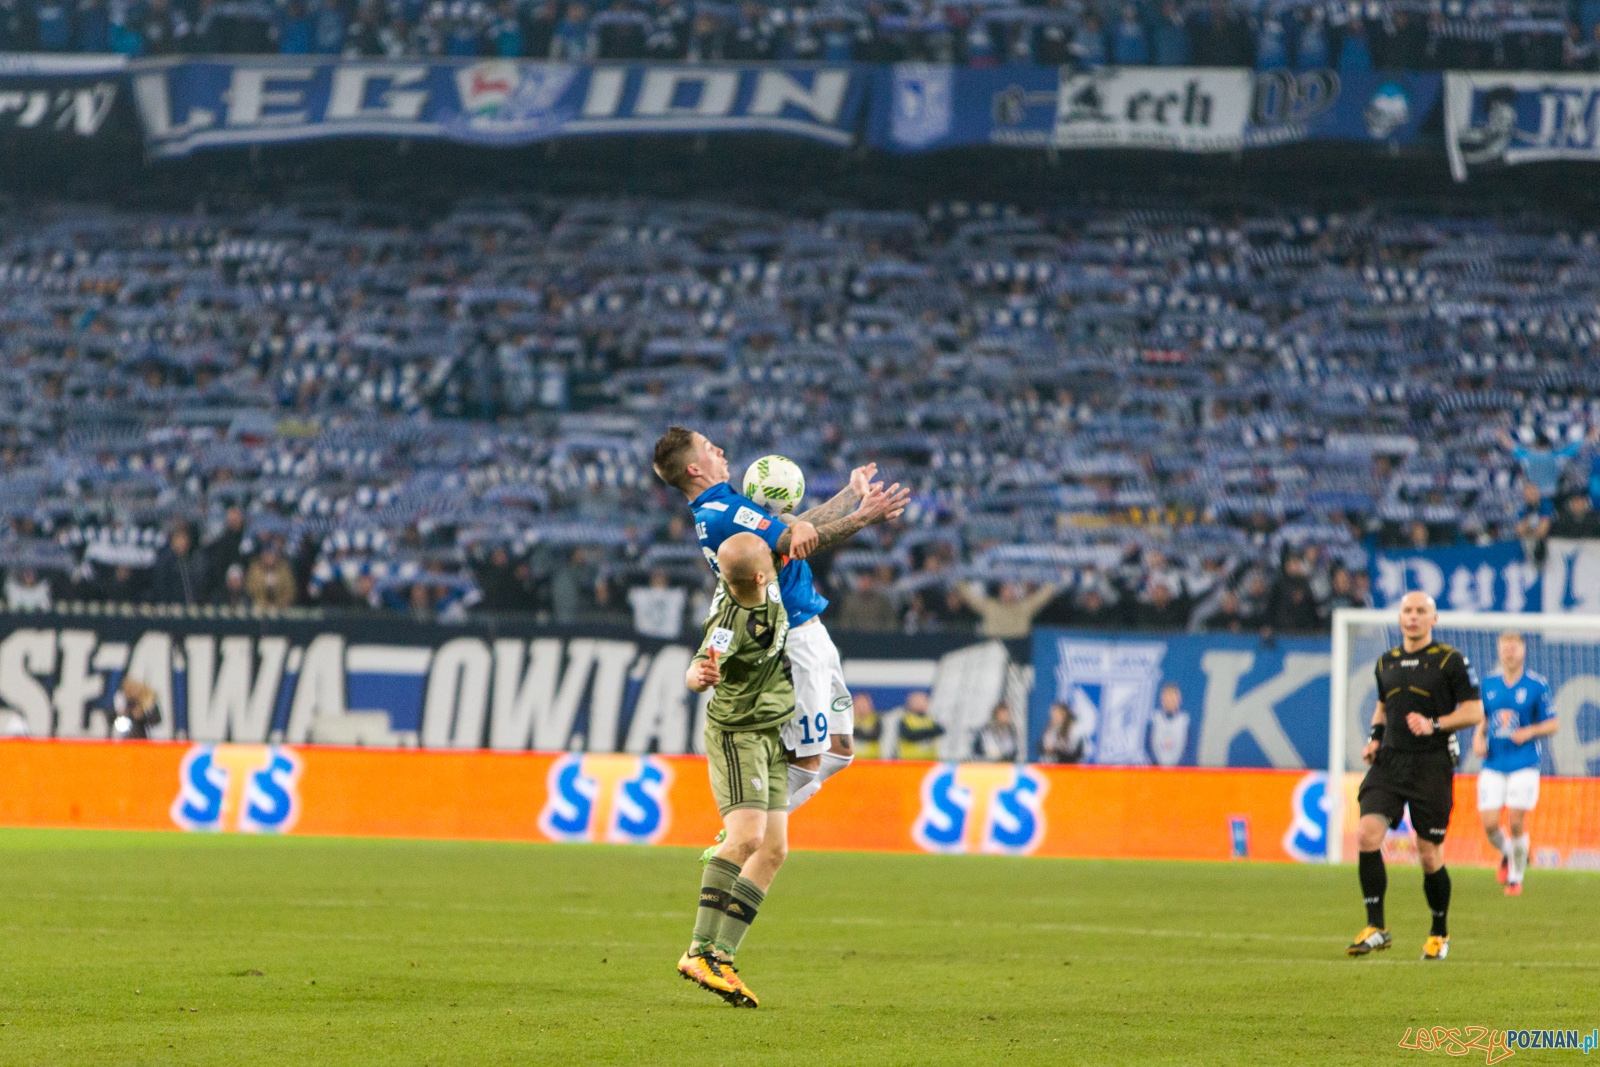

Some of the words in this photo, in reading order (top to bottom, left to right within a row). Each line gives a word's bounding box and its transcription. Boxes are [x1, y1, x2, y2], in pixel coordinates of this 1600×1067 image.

[423, 636, 706, 752] OWIA
[798, 712, 828, 744] 19
[172, 744, 298, 832] STS
[541, 754, 669, 841] STS
[914, 764, 1048, 854] STS
